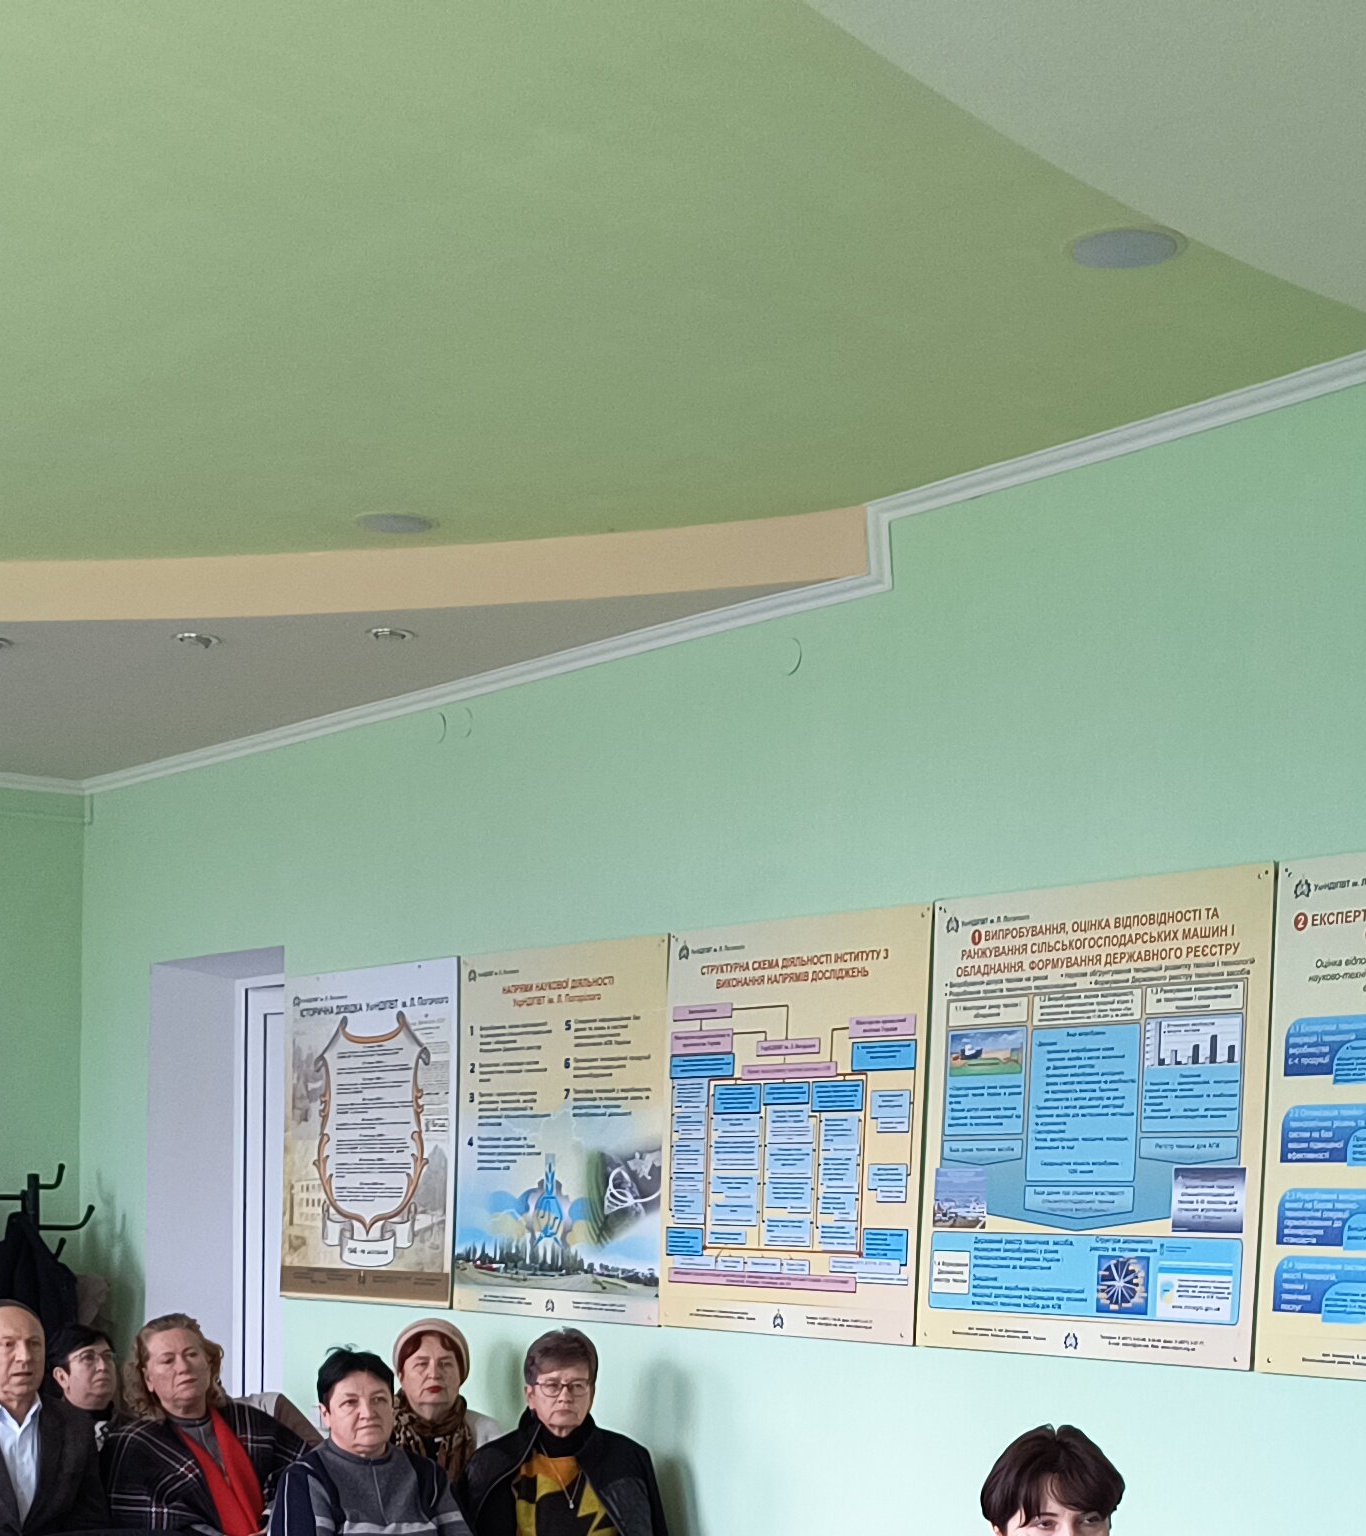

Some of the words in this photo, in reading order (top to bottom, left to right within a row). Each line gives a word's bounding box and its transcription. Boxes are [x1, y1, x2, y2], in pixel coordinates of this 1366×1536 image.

[985, 923, 1068, 941] ВИПРОБУВАННЯ,
[1071, 918, 1111, 934] ОЦІНКА
[1114, 909, 1201, 929] ВІДПОВІДНОСТІ
[1206, 907, 1219, 920] ТА
[1297, 916, 1305, 928] 2
[961, 945, 1027, 960] РАНЖУВАННЯ
[1031, 930, 1179, 954] СІЛЬСЬКОГОСПОДАРСЬКИХ
[1182, 925, 1227, 940] МАШИН
[1029, 954, 1101, 971] ФОРМУВАННЯ
[1104, 947, 1182, 967] ДЕРЖАВНОГО
[1186, 942, 1240, 958] РЕЄСТРУ
